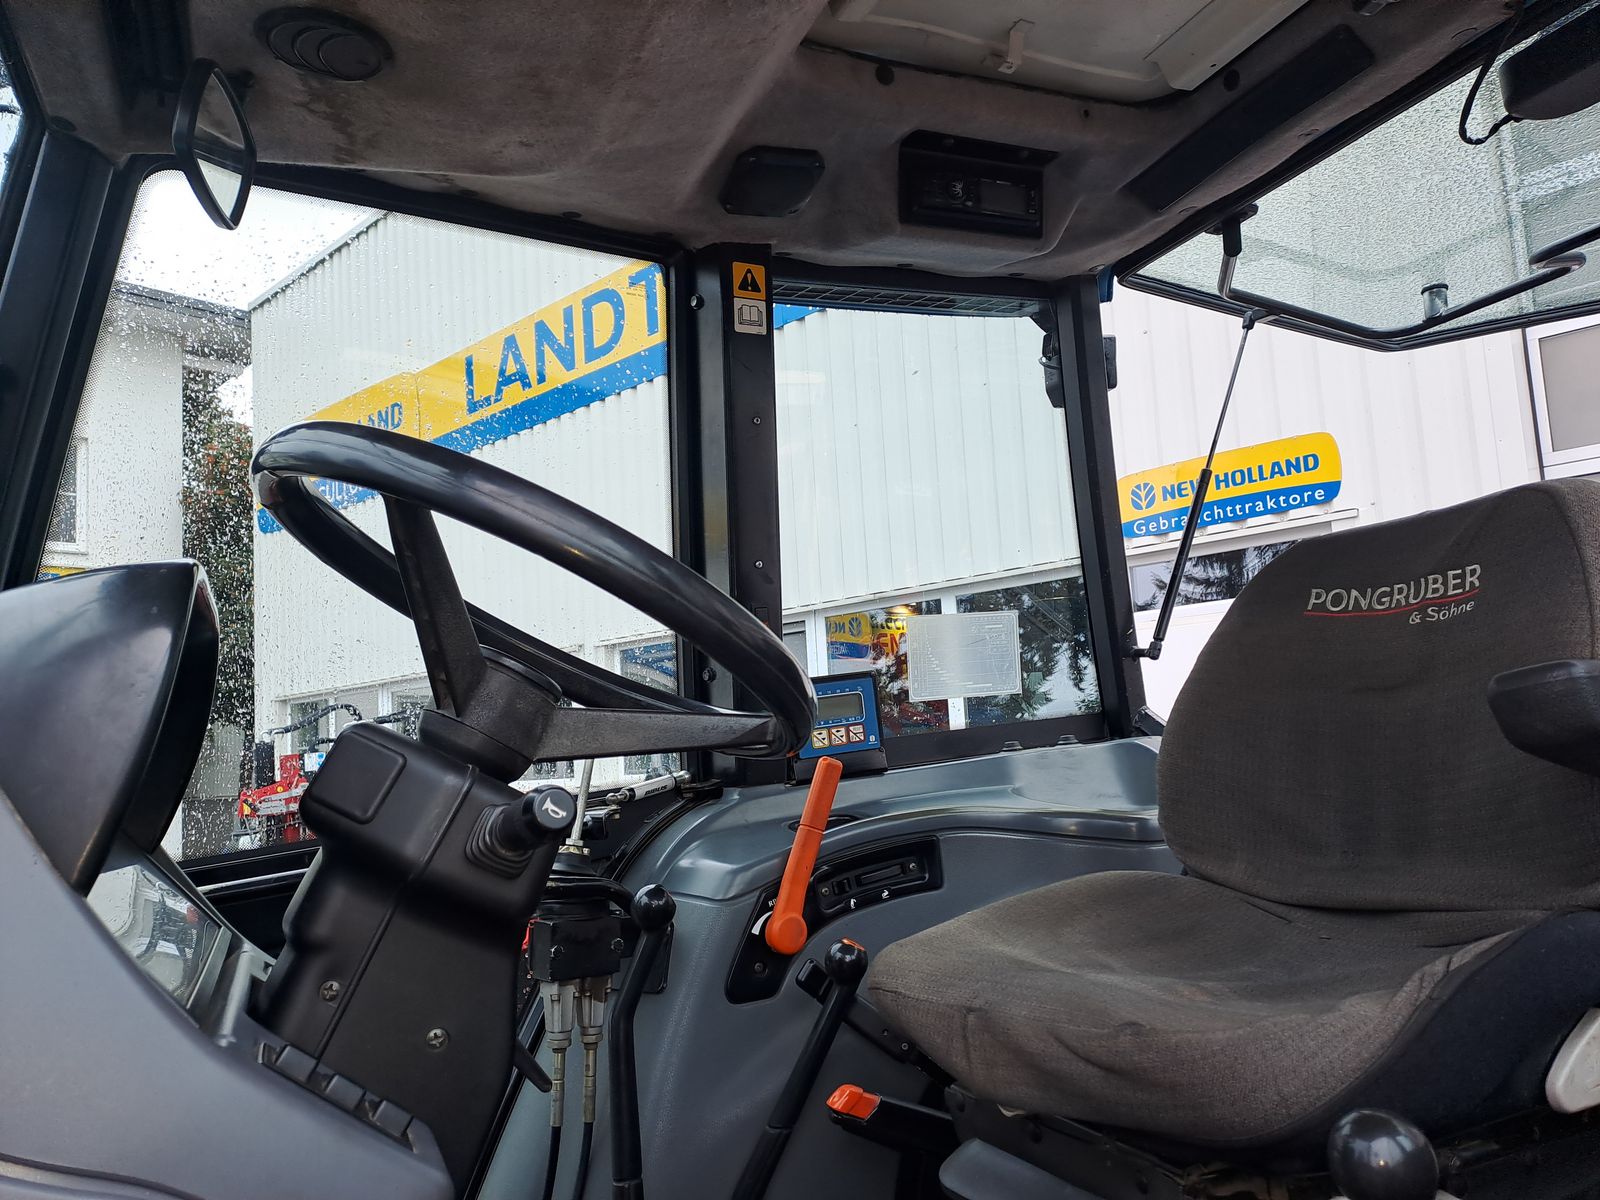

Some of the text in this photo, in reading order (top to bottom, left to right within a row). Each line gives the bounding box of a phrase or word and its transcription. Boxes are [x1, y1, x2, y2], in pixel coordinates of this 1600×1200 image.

[1215, 453, 1320, 490] HOLLAND
[1133, 488, 1326, 535] Gebrachttraktore
[1306, 564, 1482, 612] PONGRUBER
[1408, 600, 1475, 625] & Söhne
